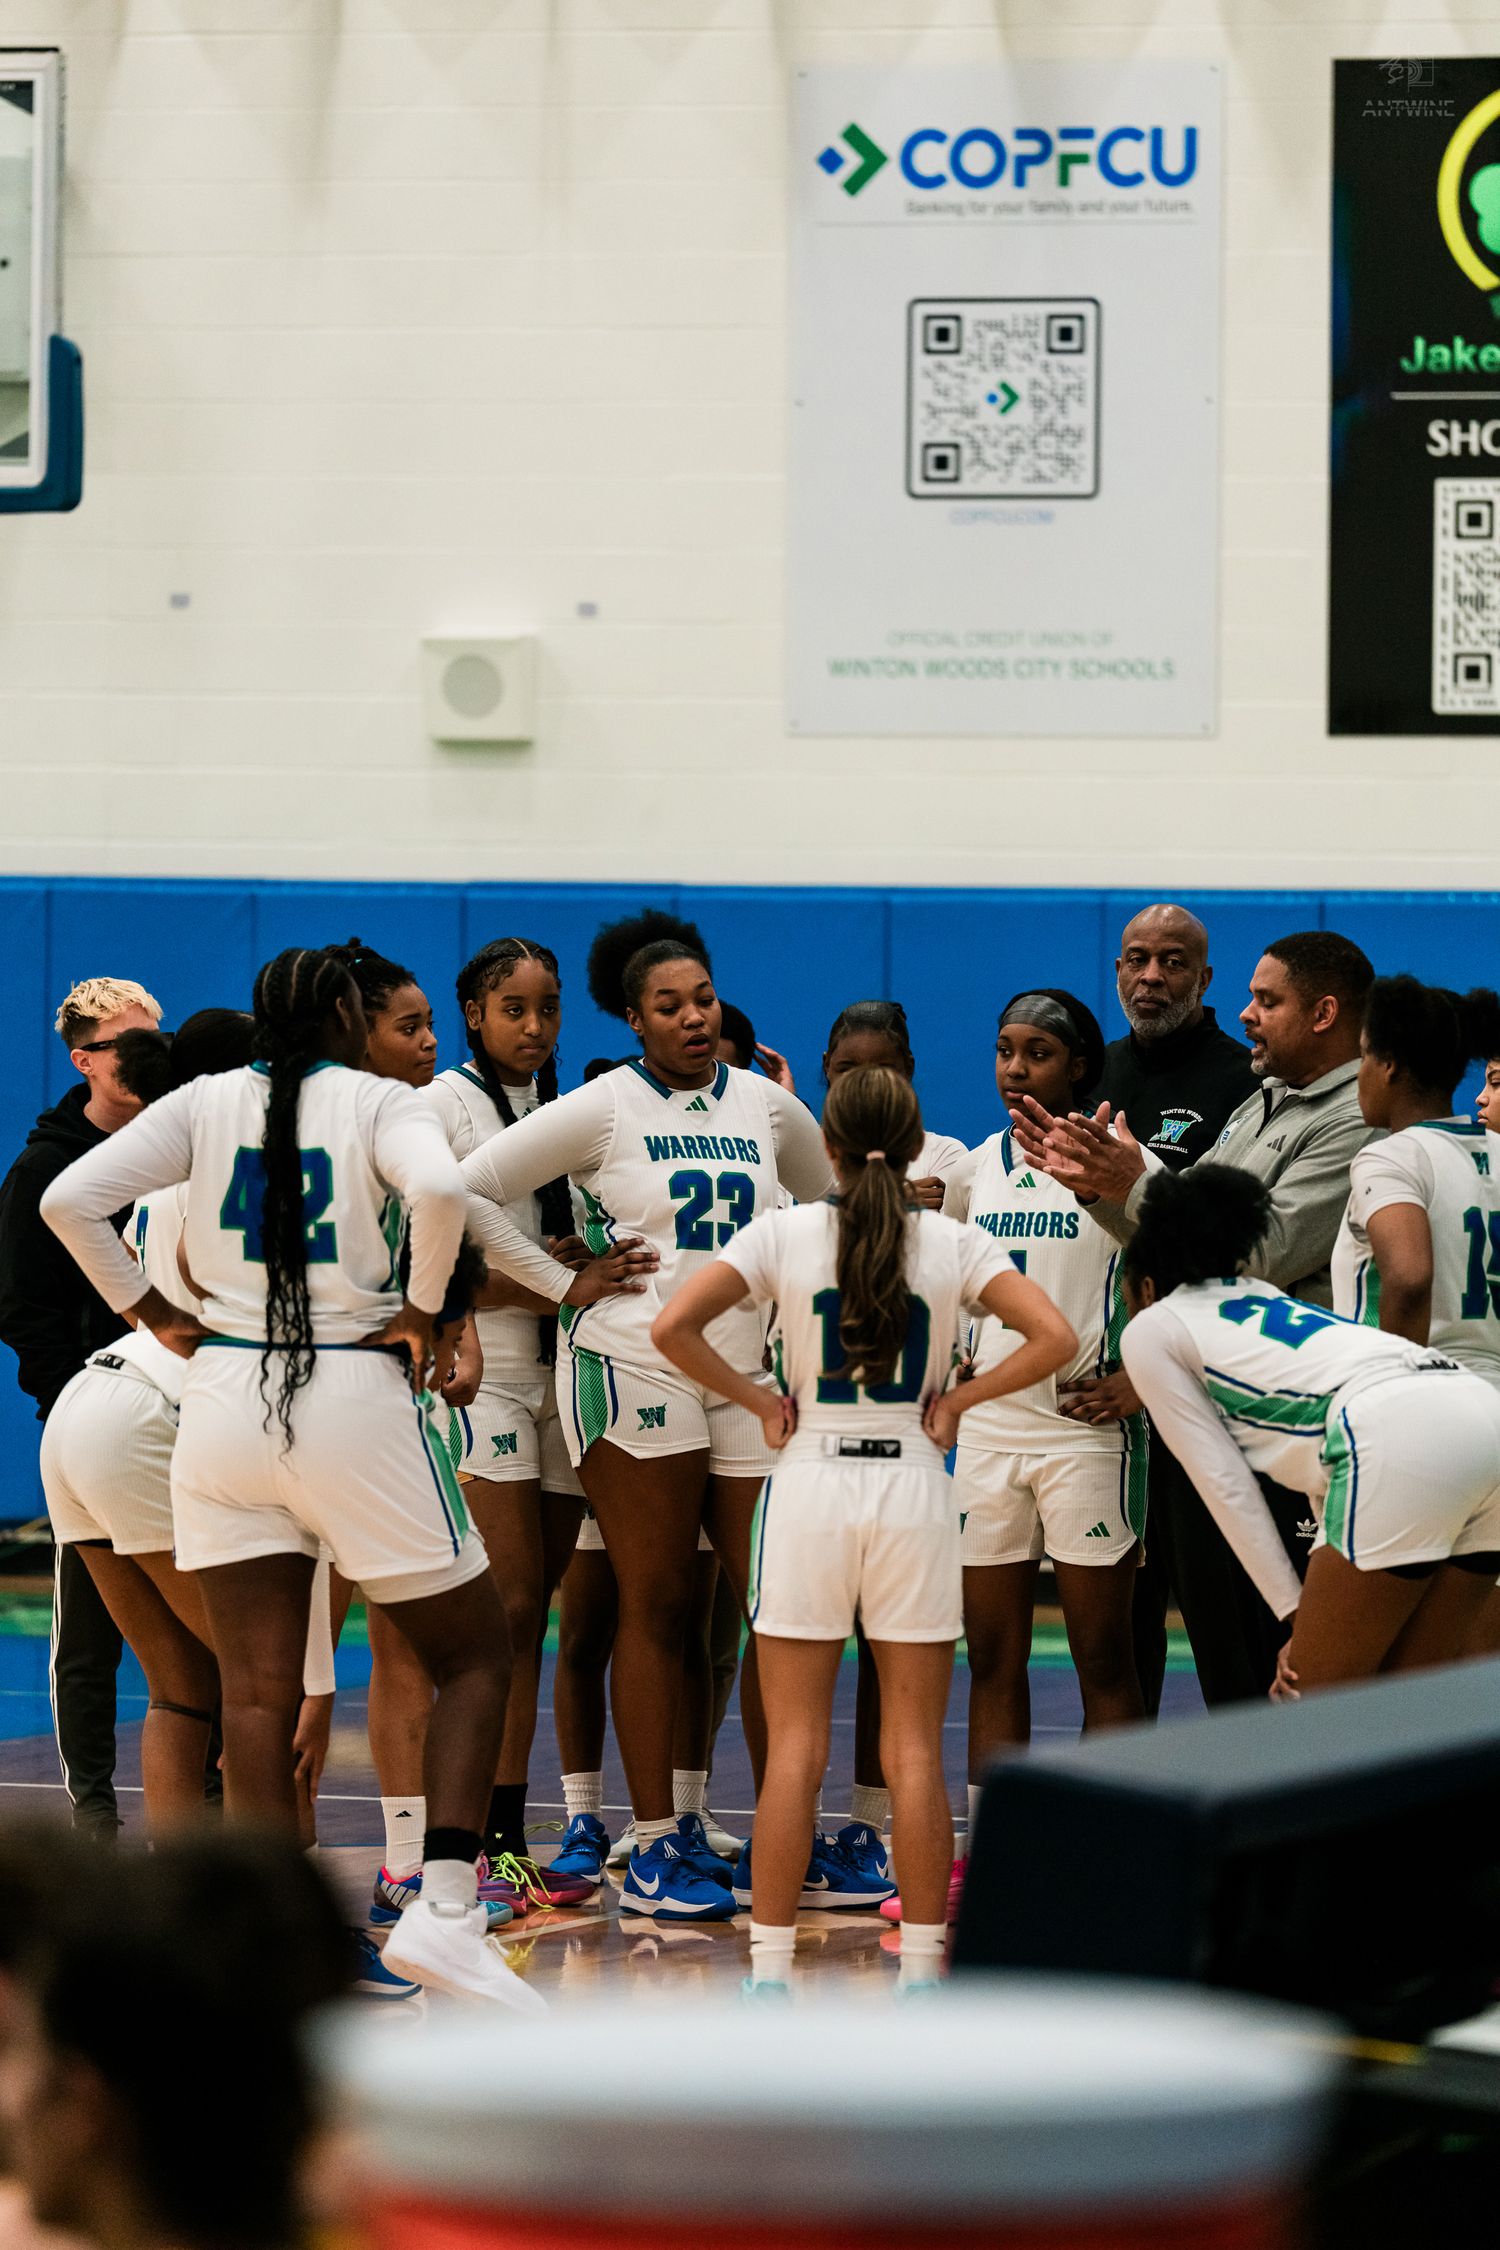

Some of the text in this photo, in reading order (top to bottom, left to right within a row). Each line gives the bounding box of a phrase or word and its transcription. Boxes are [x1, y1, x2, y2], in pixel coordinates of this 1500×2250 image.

[900, 127, 1197, 189] COPFCU
[828, 657, 1175, 678] WINTON WOODS CITY SCHOOLS
[1160, 1108, 1186, 1116] WINTON
[643, 1135, 761, 1165] WARRIORS
[220, 1146, 338, 1263] 42
[668, 1169, 755, 1251] 23
